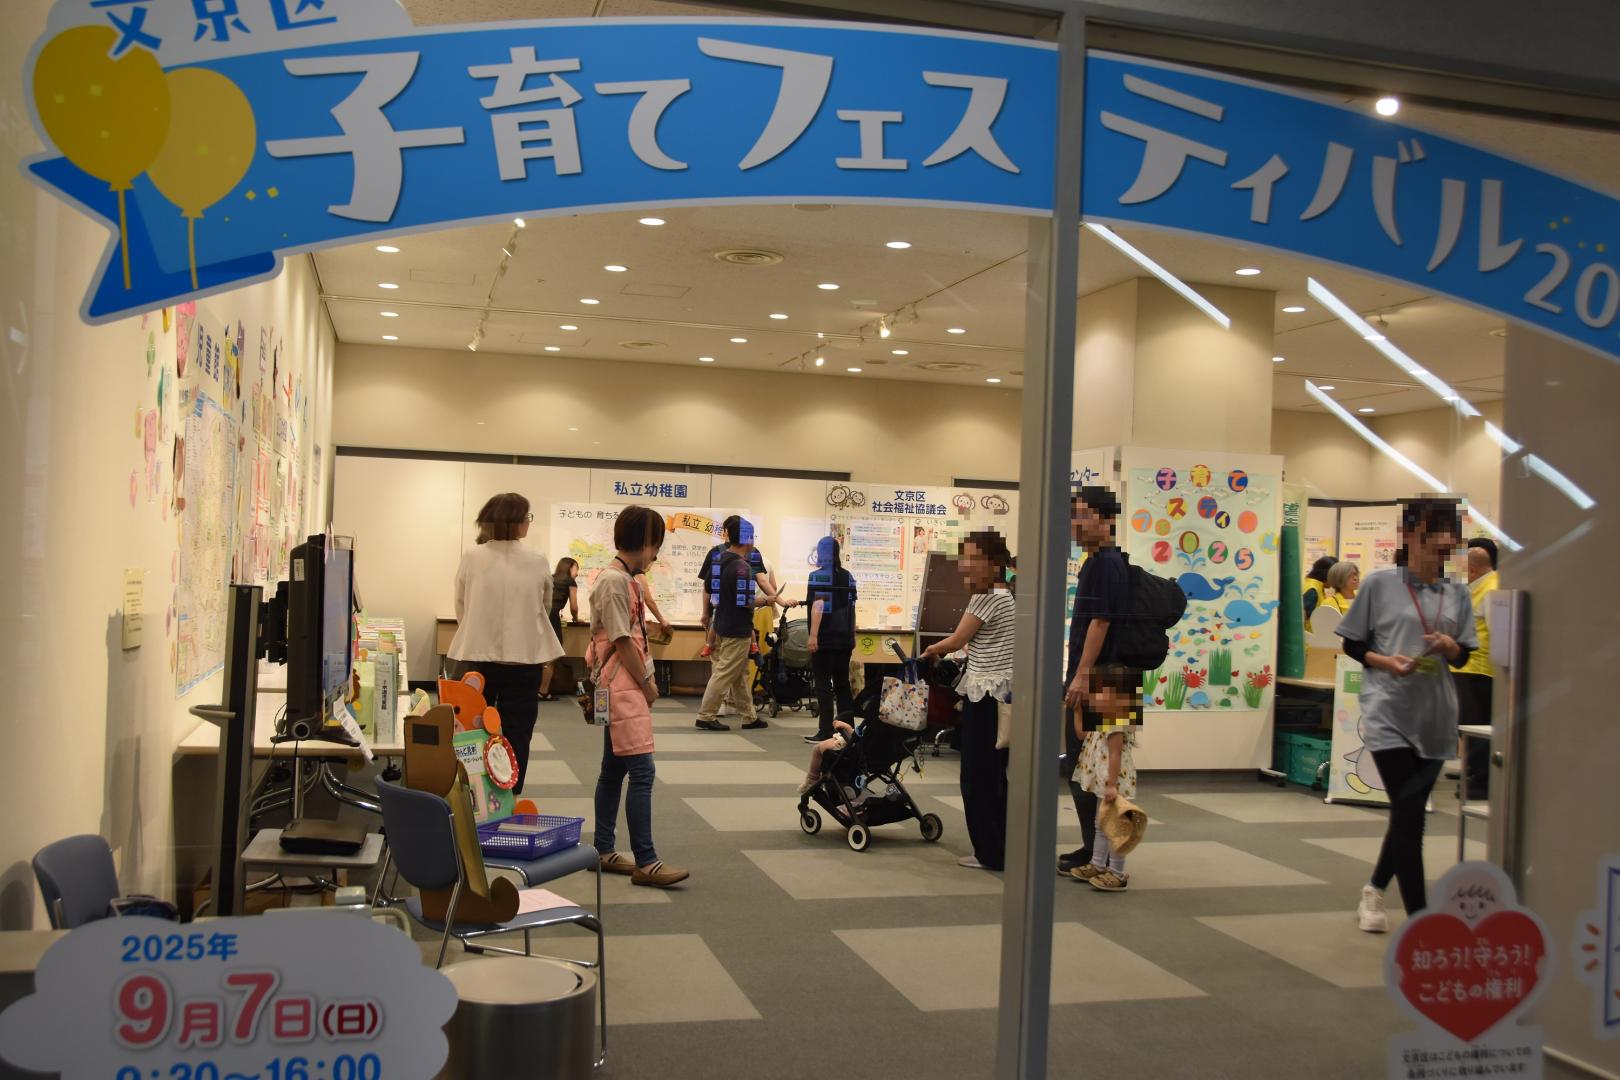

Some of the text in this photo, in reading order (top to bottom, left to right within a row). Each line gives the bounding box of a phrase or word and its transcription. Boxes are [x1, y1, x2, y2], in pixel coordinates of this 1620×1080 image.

[90, 0, 338, 56] 文京区
[265, 37, 1620, 329] 子育てフェスティバル20
[614, 481, 687, 498] 私立幼稚園
[1157, 465, 1247, 491] 子育て
[894, 490, 926, 501] 文京区
[560, 509, 592, 519] 子どもの
[872, 501, 947, 516] 社会福祉協議会
[682, 515, 701, 530] 私立
[1153, 532, 1253, 570] 2025
[121, 932, 238, 962] 2025年
[1418, 977, 1523, 1002] こどもの権利
[118, 972, 379, 1044] 9月7日(日)
